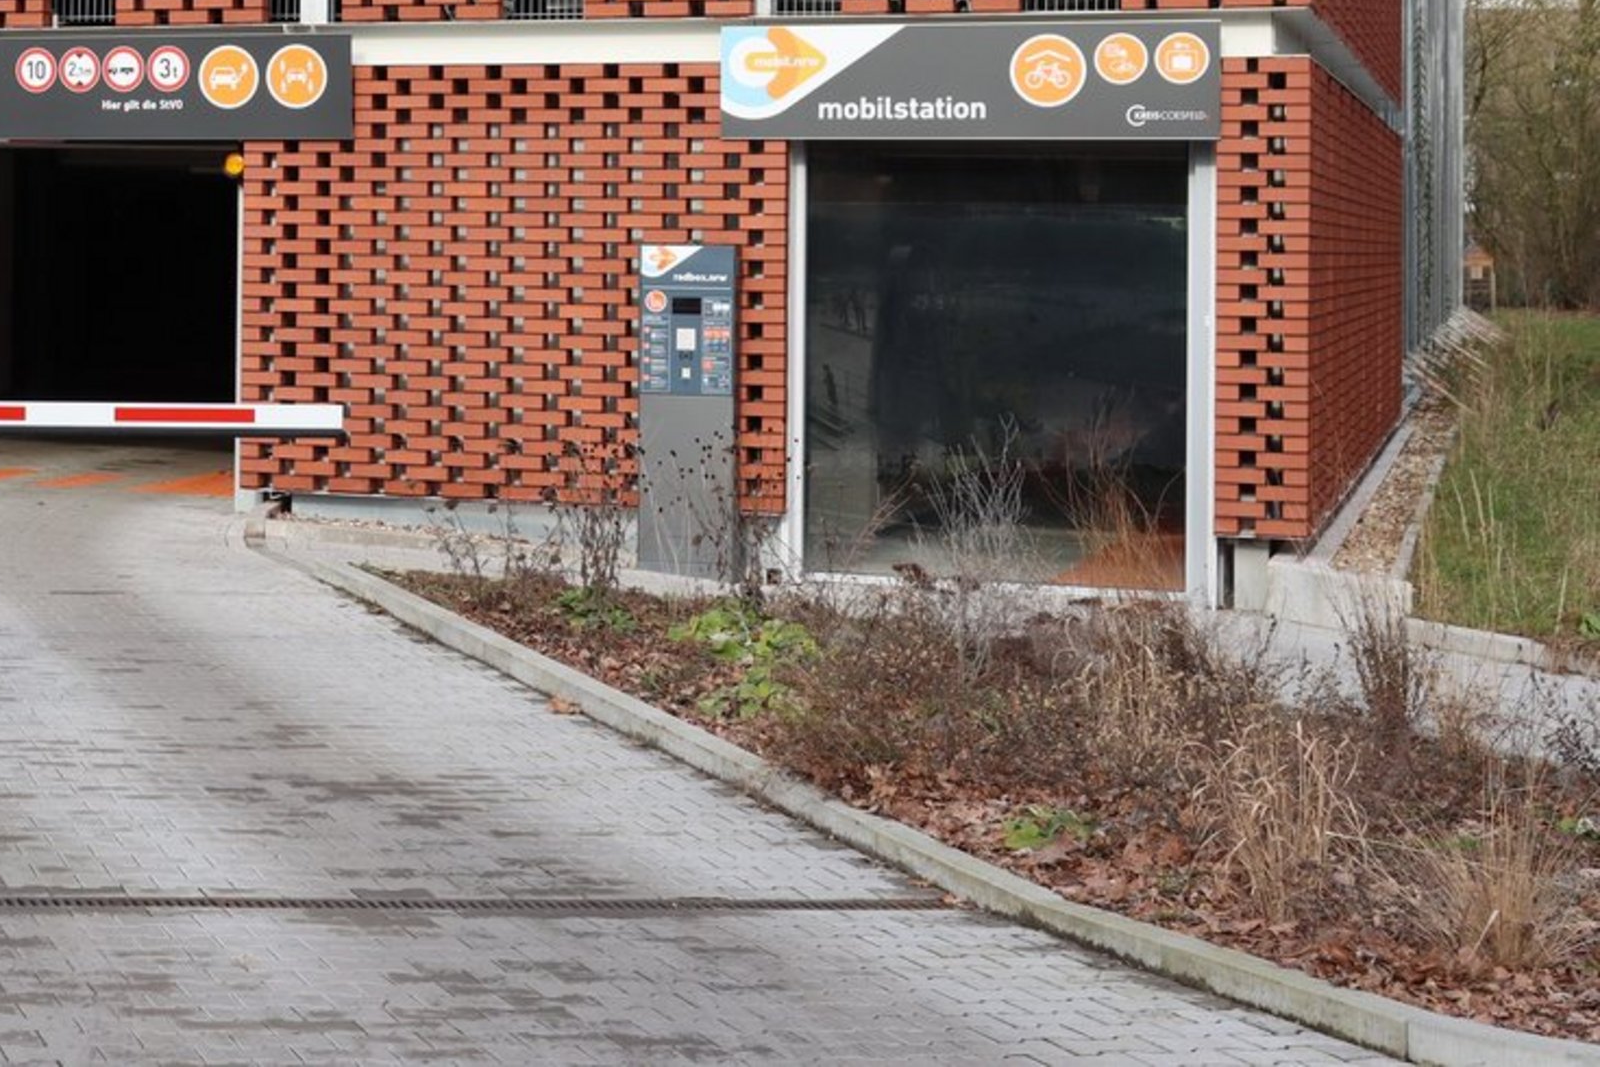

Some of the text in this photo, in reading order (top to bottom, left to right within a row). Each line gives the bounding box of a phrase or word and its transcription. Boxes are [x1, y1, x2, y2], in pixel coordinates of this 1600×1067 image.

[27, 61, 46, 80] 10
[101, 99, 184, 112] Hier gilt die StVO
[817, 96, 988, 121] mobilstation
